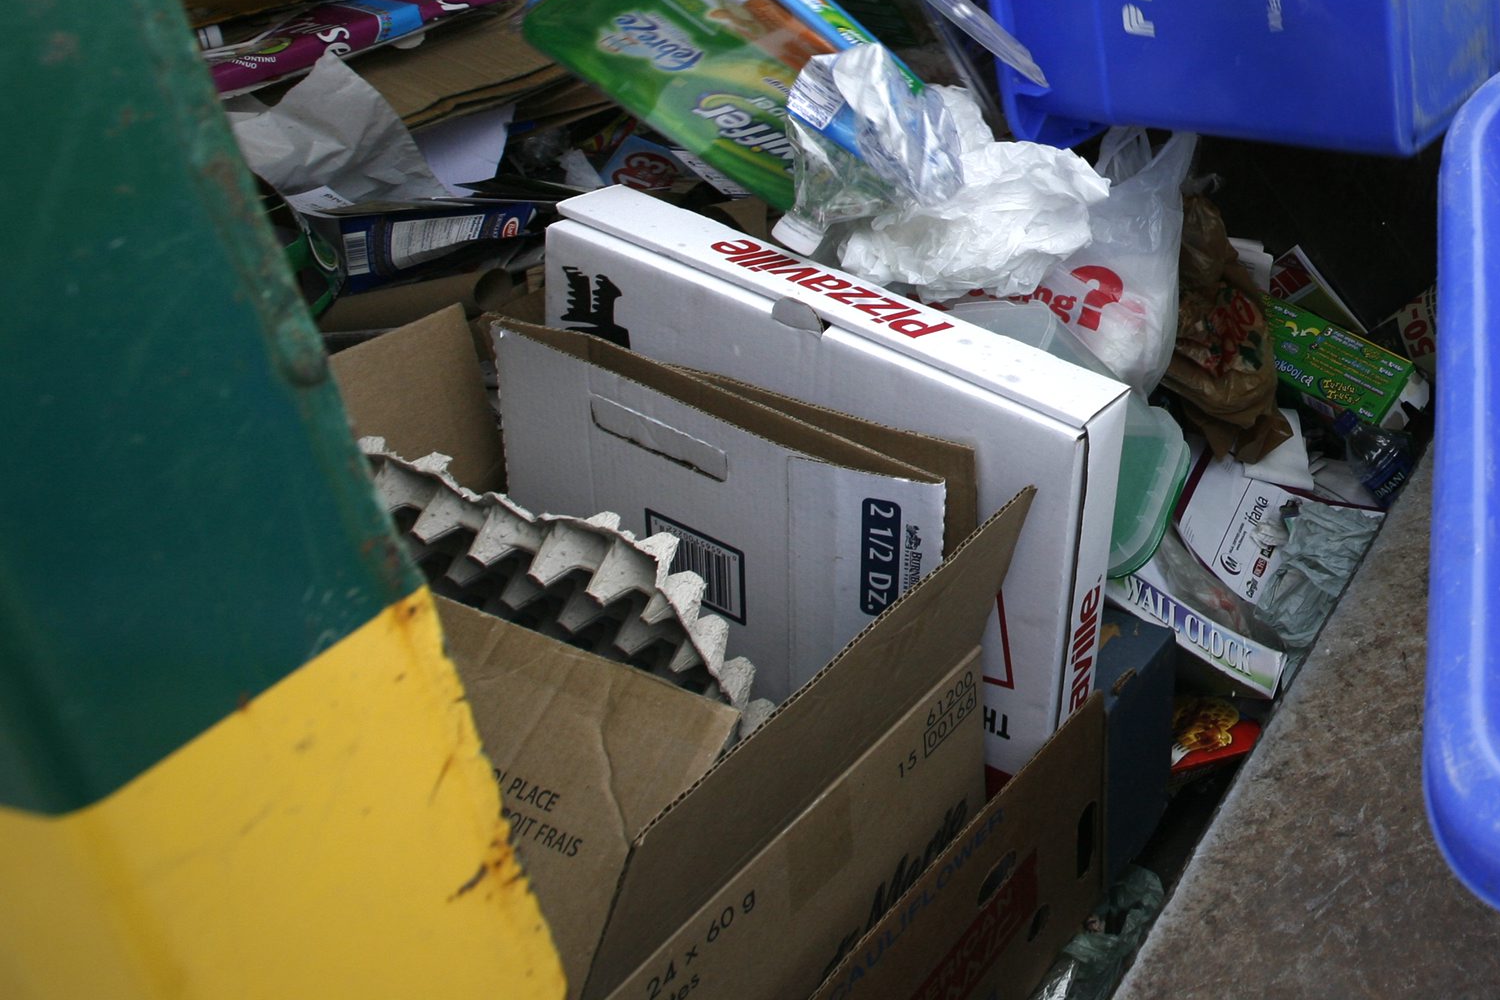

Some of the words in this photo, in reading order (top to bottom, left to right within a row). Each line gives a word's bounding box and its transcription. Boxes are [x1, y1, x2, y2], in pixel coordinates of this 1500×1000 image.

[691, 104, 796, 175] wiffer
[710, 239, 955, 339] Pizzaville
[1374, 471, 1406, 499] DASANI
[870, 503, 895, 519] 2
[869, 527, 895, 563] 1/2
[867, 571, 893, 610] DZ.
[1123, 576, 1180, 634] WALL
[1185, 614, 1253, 677] CLOCK
[926, 670, 974, 727] 61200
[897, 749, 917, 779] 15
[927, 695, 975, 748] 00166
[507, 777, 560, 812] PLACE
[534, 823, 583, 857] FRAIS
[647, 960, 677, 1000] 24
[706, 906, 734, 943] 60
[742, 889, 755, 914] g
